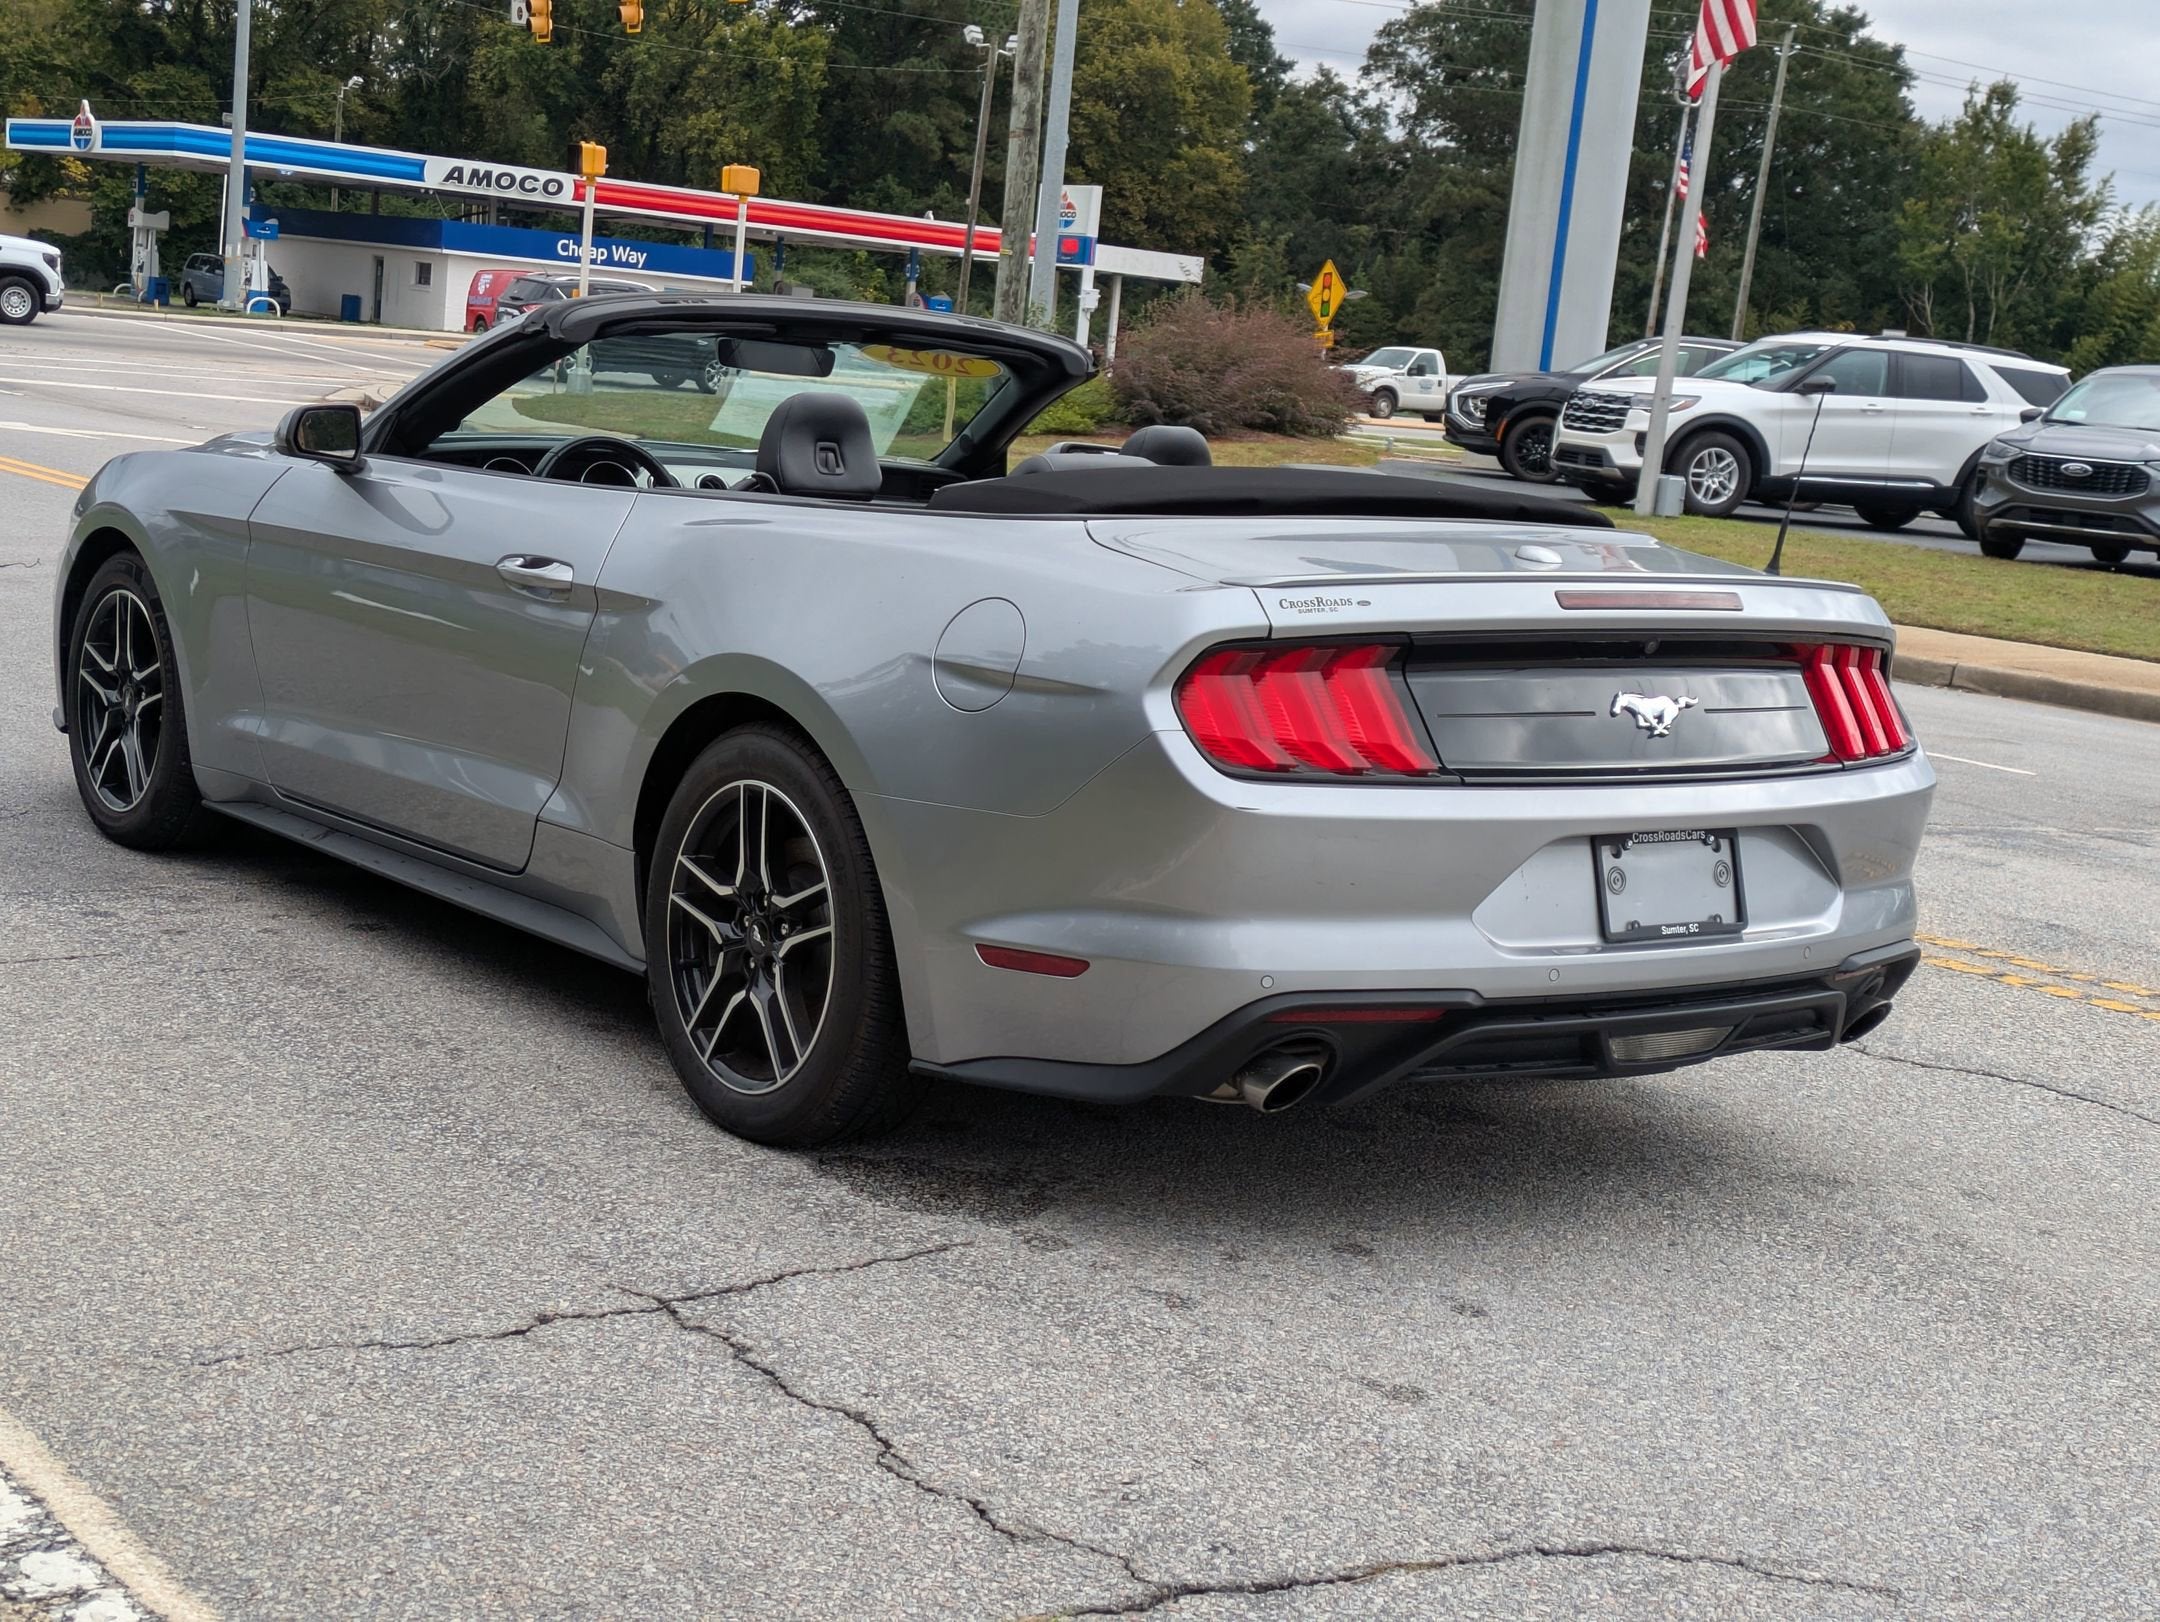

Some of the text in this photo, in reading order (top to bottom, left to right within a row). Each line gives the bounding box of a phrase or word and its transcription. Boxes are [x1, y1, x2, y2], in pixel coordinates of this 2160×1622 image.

[442, 166, 564, 196] AMOCO
[612, 244, 647, 268] Way
[1632, 830, 1706, 844] CrossRoadsCars
[1661, 923, 1699, 935] Sumter, SC
